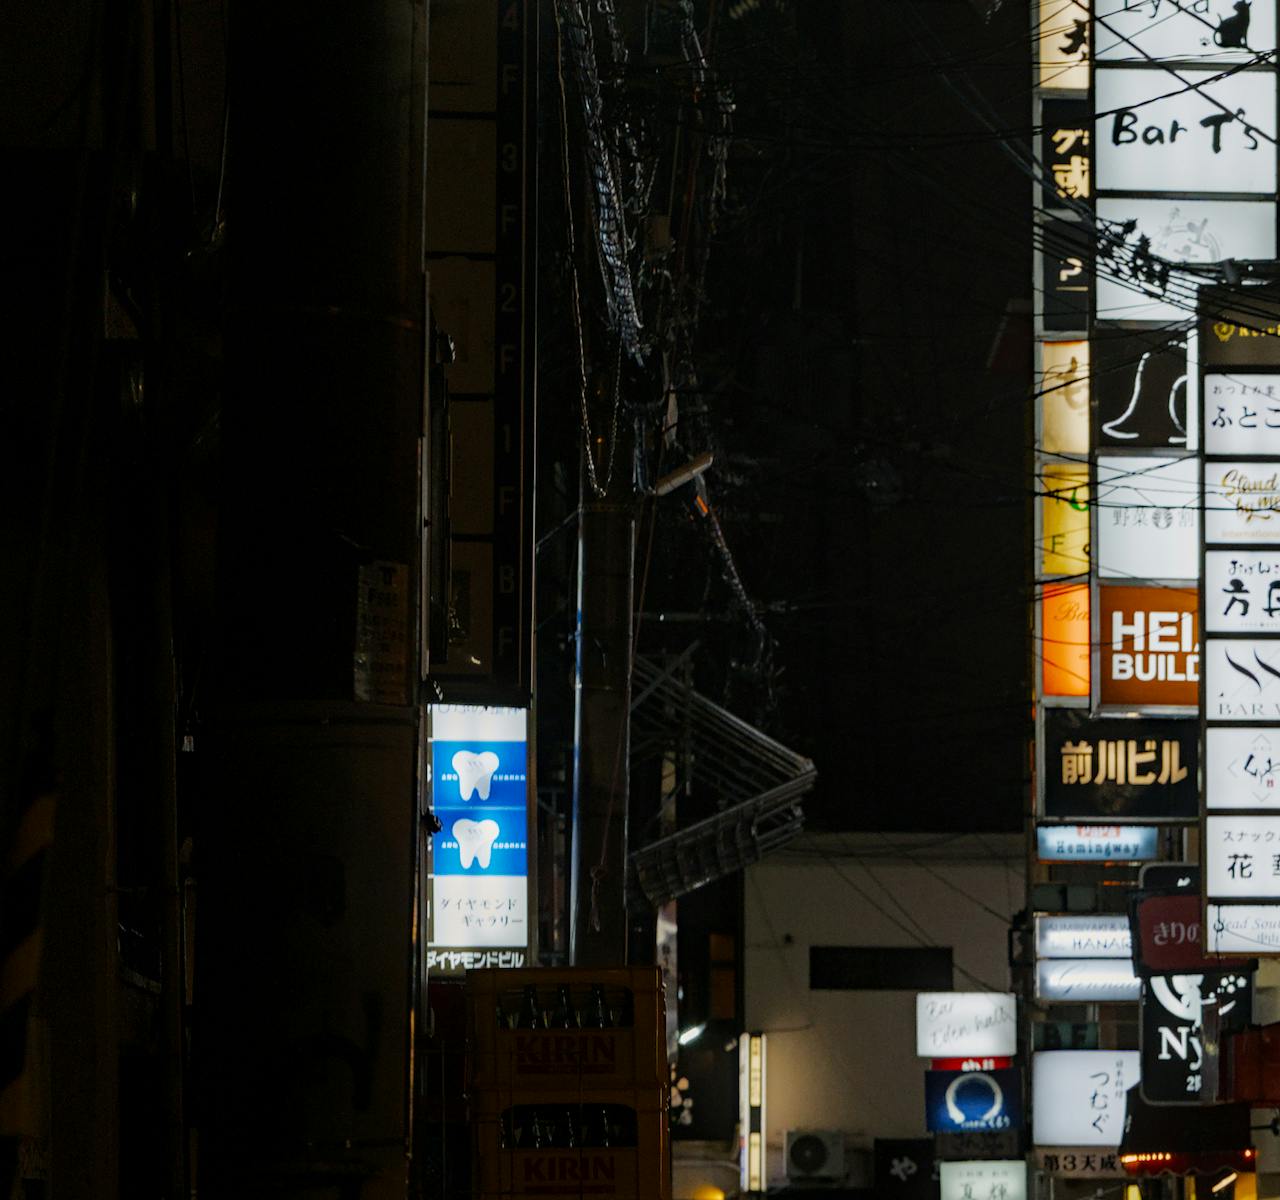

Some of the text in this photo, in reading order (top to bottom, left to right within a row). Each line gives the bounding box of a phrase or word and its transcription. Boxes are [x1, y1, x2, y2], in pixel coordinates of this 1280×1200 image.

[1112, 112, 1188, 147] Bar
[1111, 610, 1200, 653] HEI
[1060, 739, 1188, 786] 前川ビル
[1089, 1070, 1112, 1135] つむぐ
[522, 1156, 615, 1182] KIRIN
